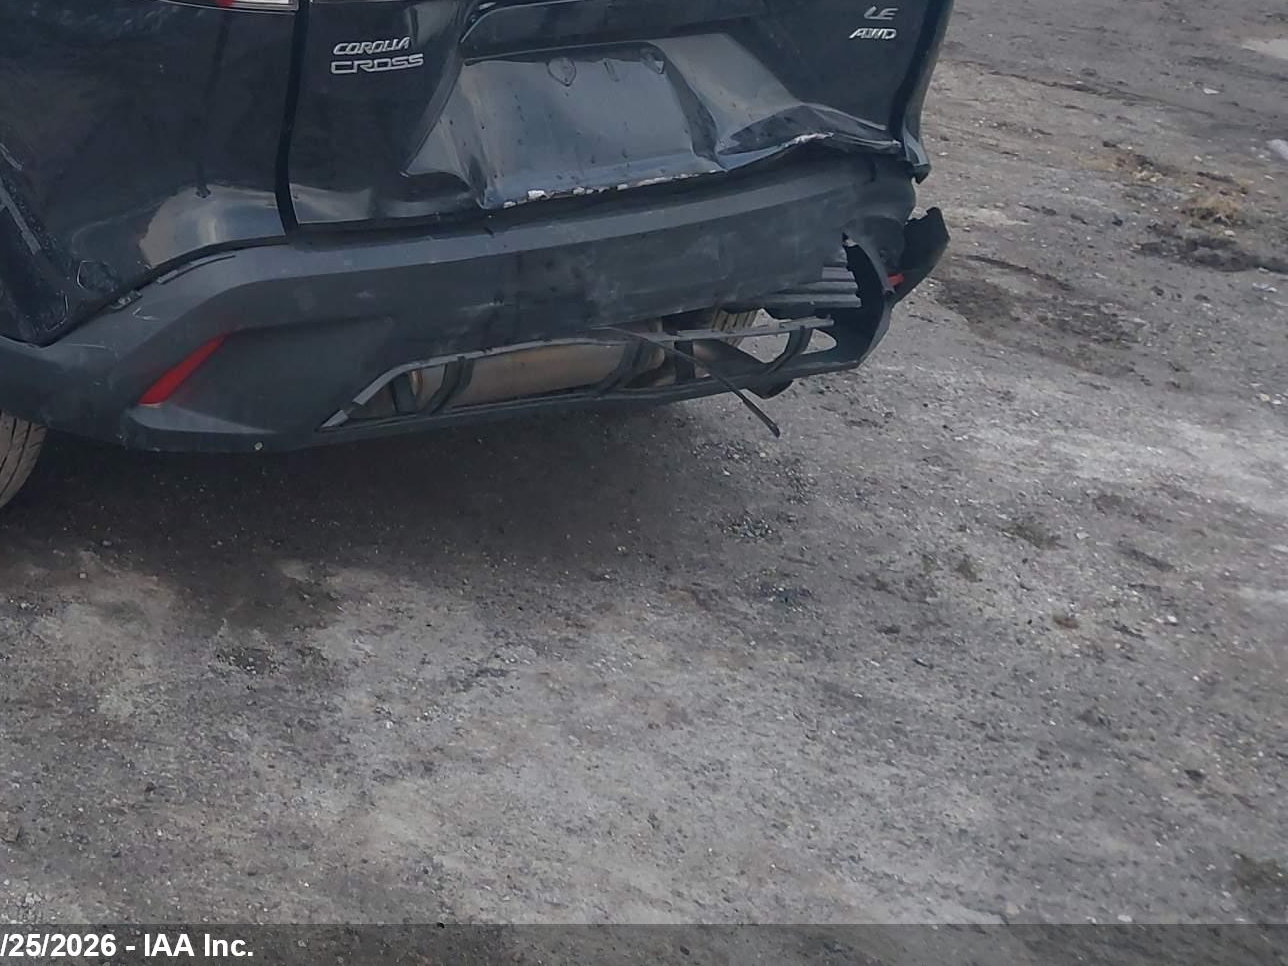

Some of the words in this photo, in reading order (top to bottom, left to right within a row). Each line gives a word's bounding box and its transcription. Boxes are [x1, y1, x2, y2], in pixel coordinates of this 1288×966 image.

[863, 5, 899, 20] LE
[848, 27, 897, 40] AWD
[333, 36, 410, 55] COROLLA
[331, 53, 424, 74] CROSS
